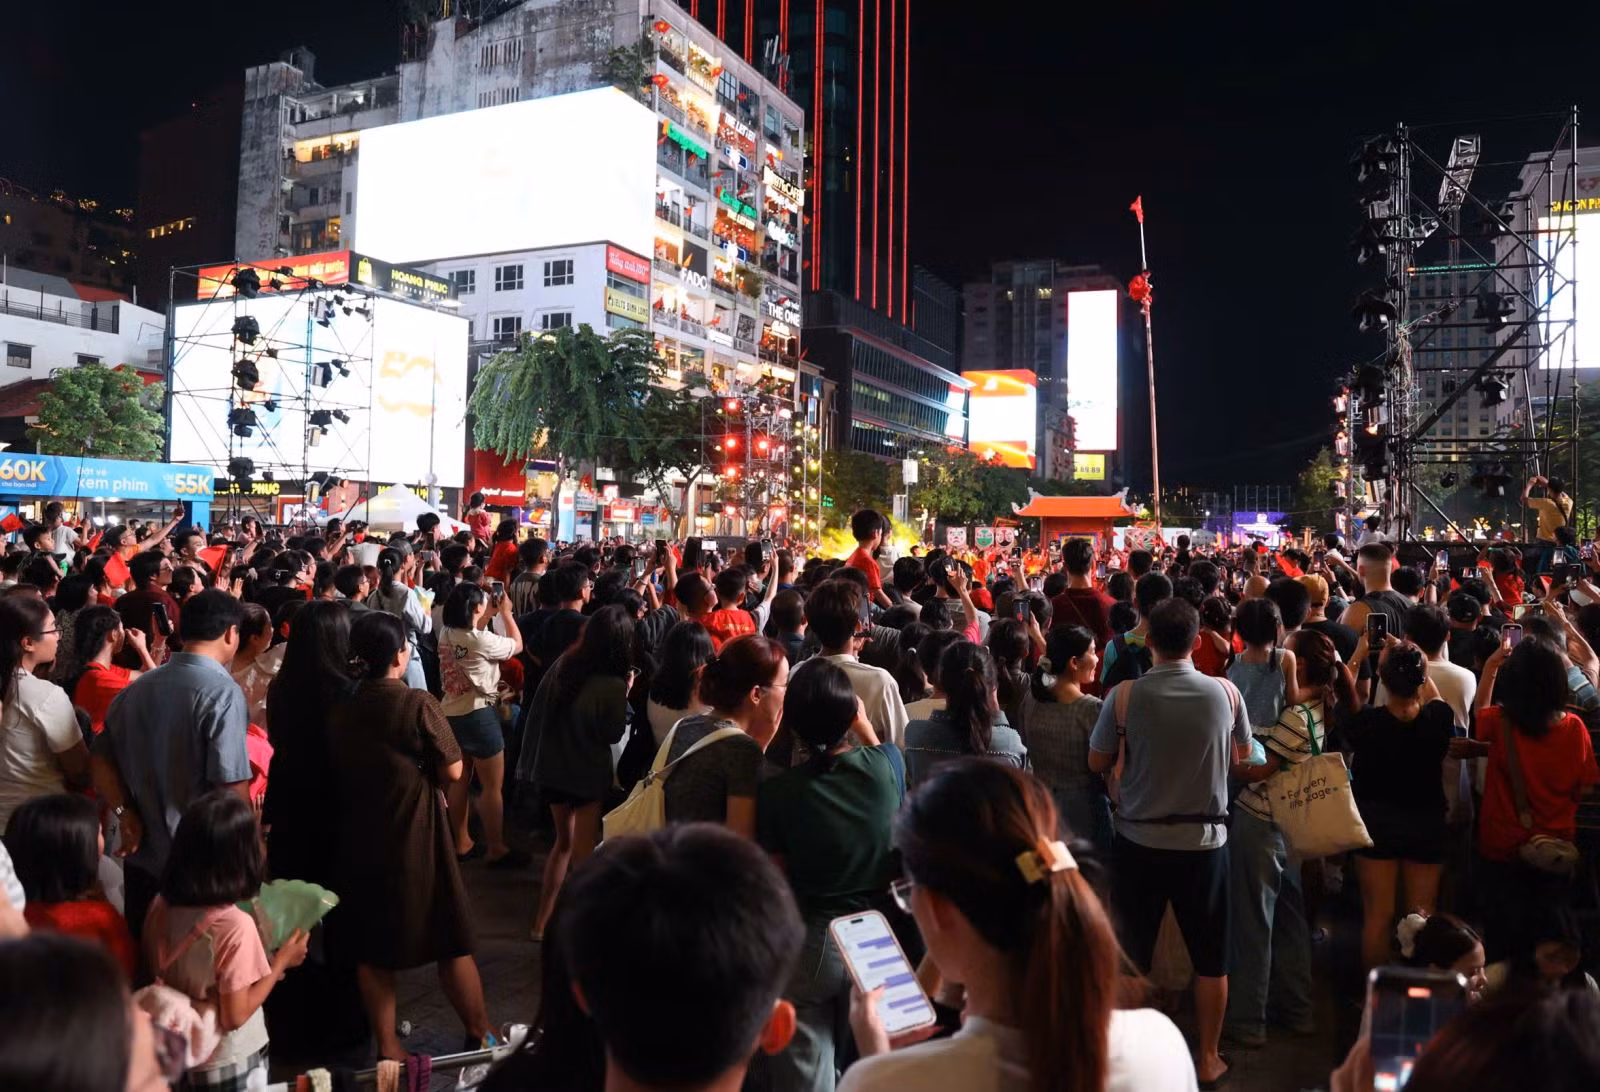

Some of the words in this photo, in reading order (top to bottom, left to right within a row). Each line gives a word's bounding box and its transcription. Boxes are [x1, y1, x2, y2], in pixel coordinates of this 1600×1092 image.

[424, 278, 448, 294] PHUC
[681, 267, 708, 290] FADO
[768, 302, 783, 320] THE
[784, 309, 800, 327] ONE
[113, 478, 148, 493] phim
[175, 473, 211, 495] 55K
[251, 483, 280, 495] PHUC
